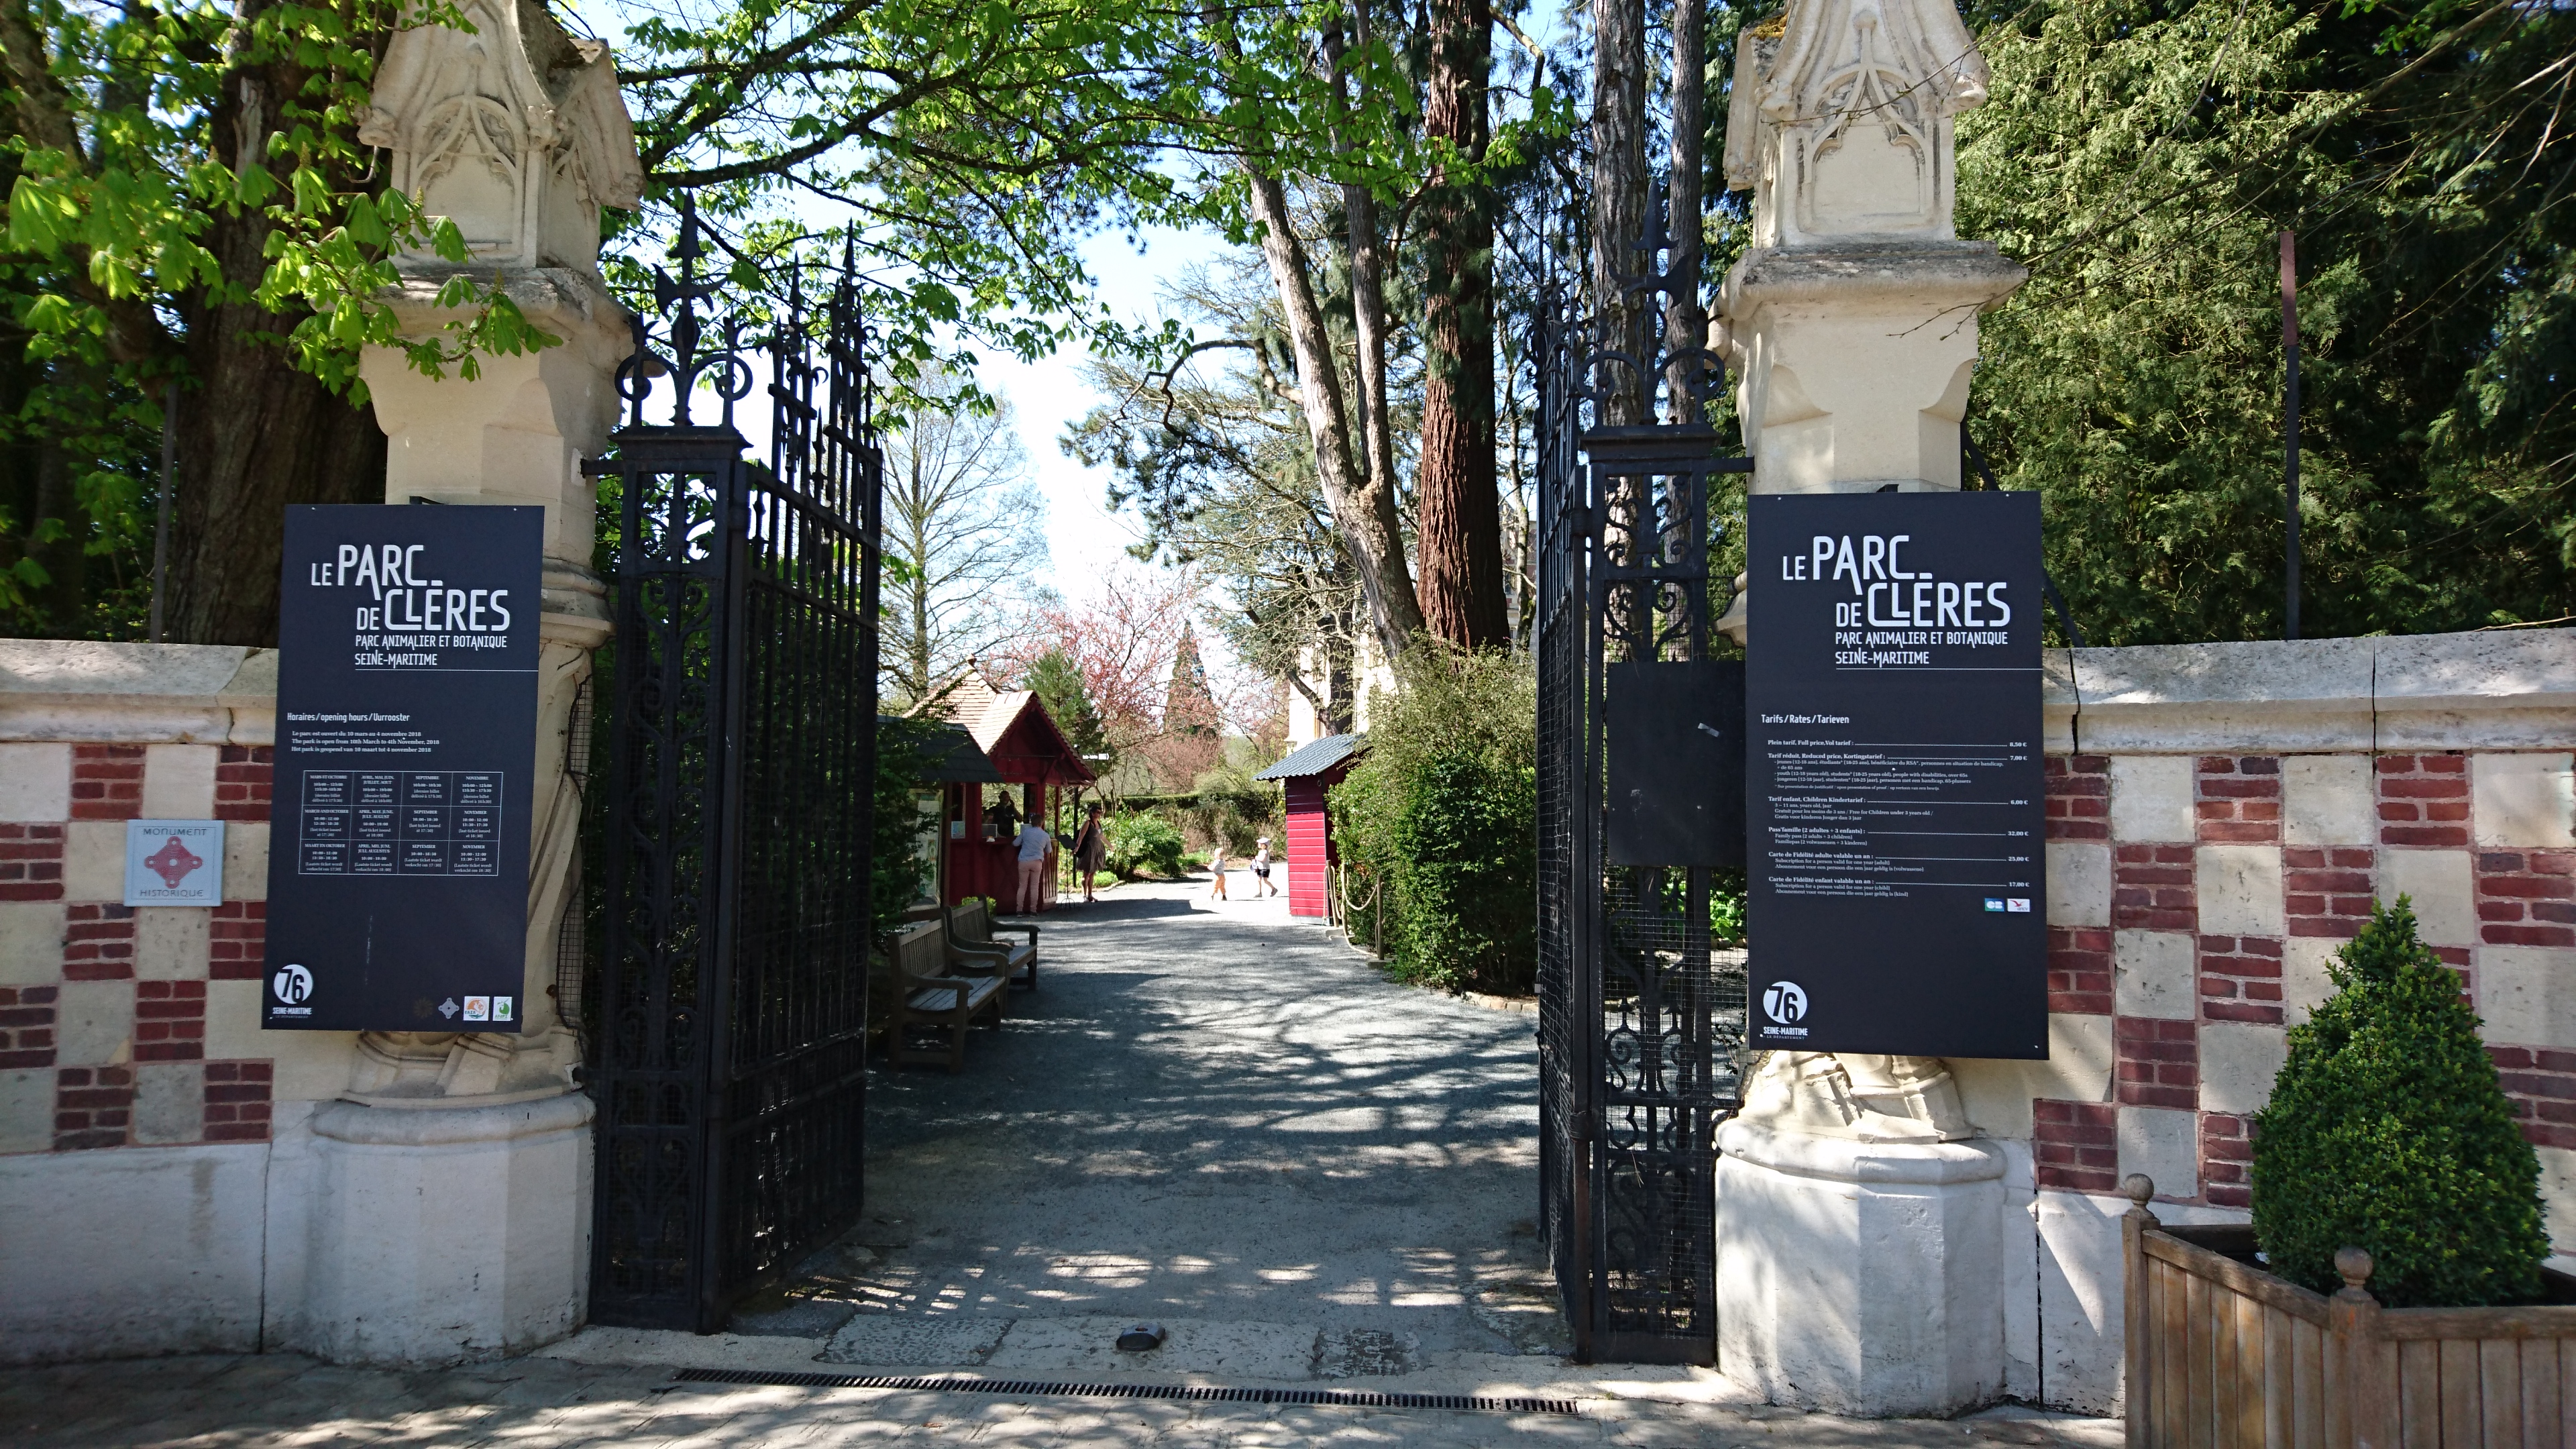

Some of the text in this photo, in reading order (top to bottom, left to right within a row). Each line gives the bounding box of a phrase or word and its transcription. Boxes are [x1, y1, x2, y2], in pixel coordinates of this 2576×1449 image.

[311, 544, 427, 601] LE PARC
[1783, 535, 1915, 595] LE PARC
[357, 607, 380, 631] DE
[1836, 602, 1862, 627] DE
[356, 635, 507, 651] PARC ANIMALIER ET BOTANIQUE
[1835, 631, 2008, 649] PARC ANIMALIER ET BOTANIQUE
[355, 649, 438, 669] SEINE-MARITIME
[1835, 647, 1929, 668] SEINE-MARITIME
[143, 828, 207, 836] MONUMENT
[140, 890, 204, 898] HISTORIQUE
[278, 969, 305, 1003] 76
[272, 1007, 313, 1015] SEINE-MARITIME
[1768, 986, 1798, 1023] 76
[1763, 1026, 1808, 1036] SEINE-MARITIME
